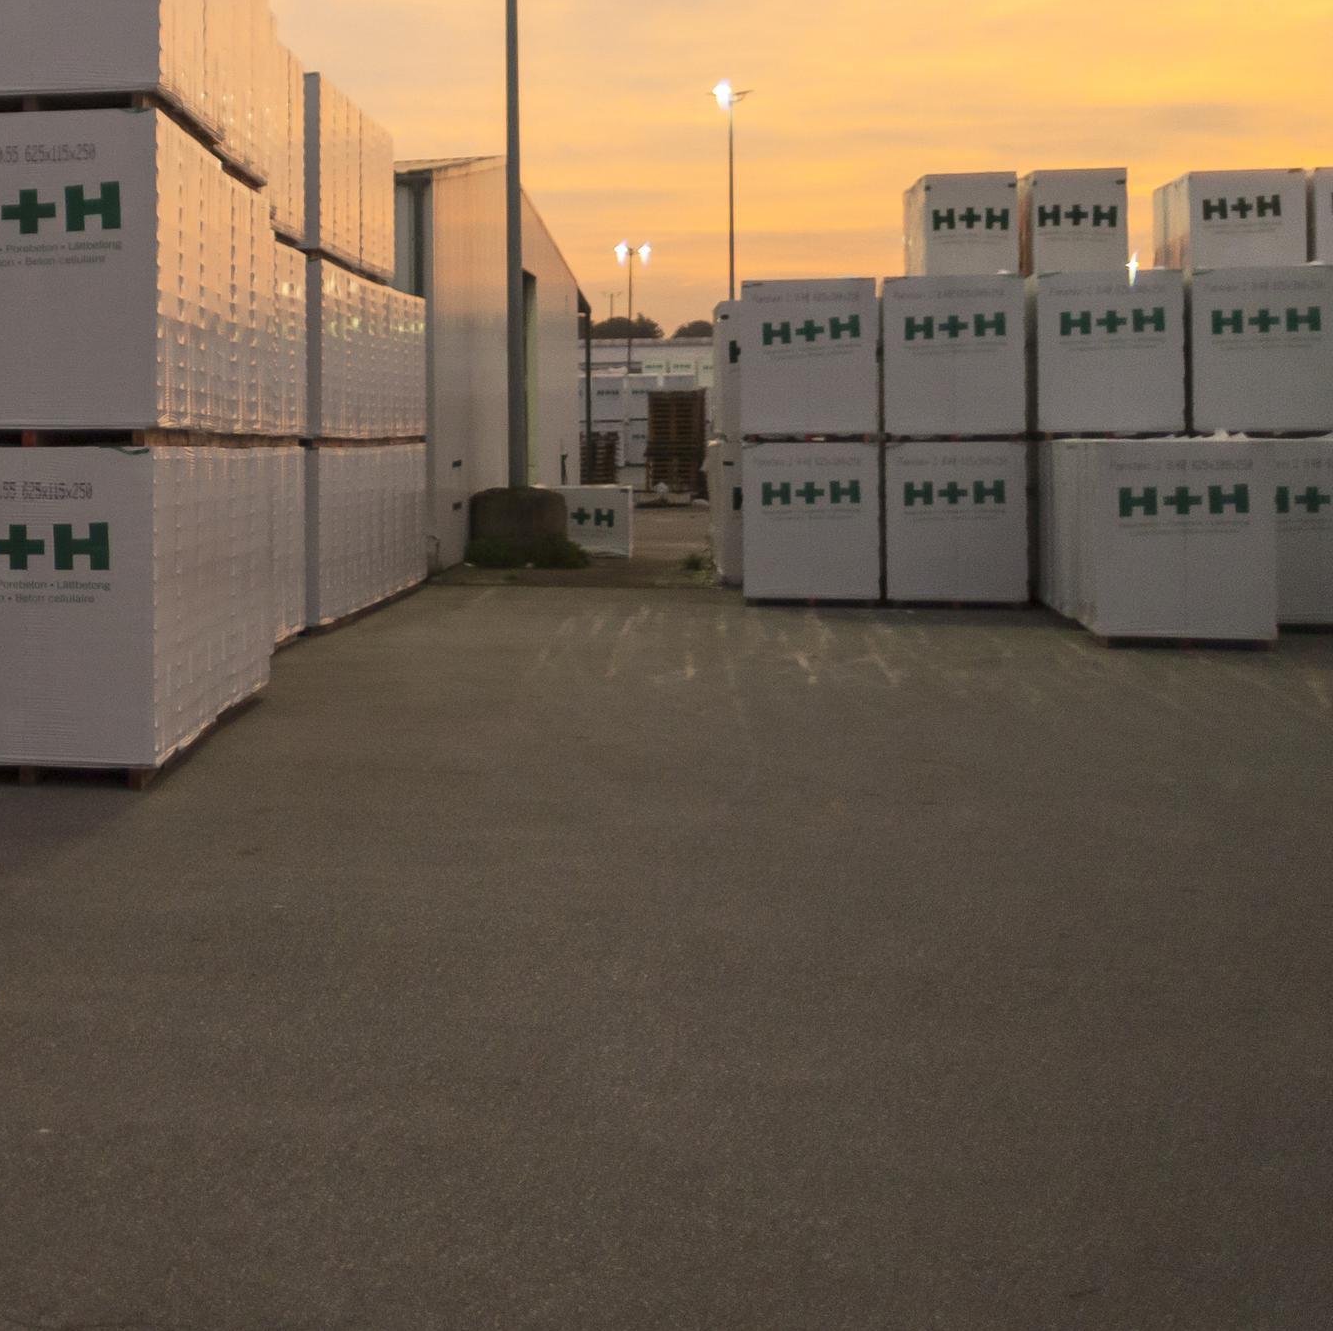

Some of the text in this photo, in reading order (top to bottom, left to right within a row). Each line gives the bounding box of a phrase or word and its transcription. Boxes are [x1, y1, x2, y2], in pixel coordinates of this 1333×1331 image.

[932, 207, 1010, 231] H+H
[1038, 204, 1118, 228] H+H
[1203, 194, 1281, 221] H+H
[762, 314, 860, 345] H+H
[904, 311, 1006, 341] H+H
[1060, 307, 1165, 336] H+H
[1211, 306, 1321, 335] H+H
[762, 479, 860, 506] H+H
[904, 479, 1005, 506] H+H
[1119, 483, 1249, 517] H+H
[570, 507, 615, 528] +H
